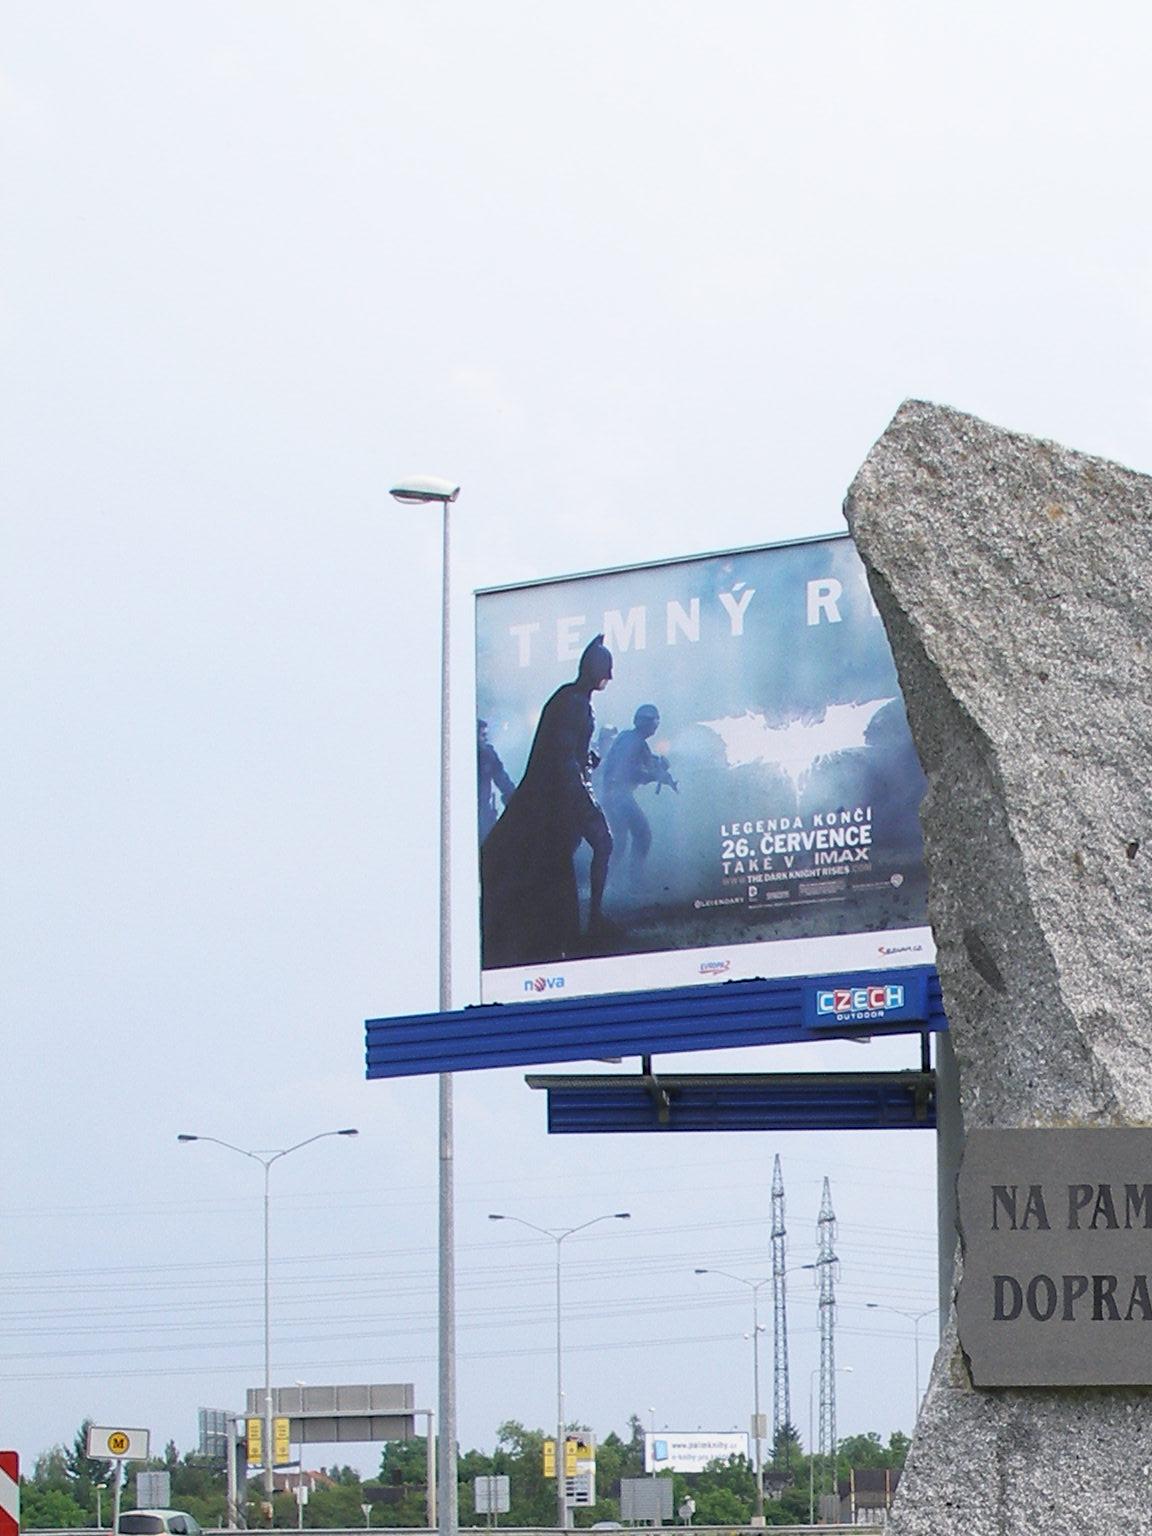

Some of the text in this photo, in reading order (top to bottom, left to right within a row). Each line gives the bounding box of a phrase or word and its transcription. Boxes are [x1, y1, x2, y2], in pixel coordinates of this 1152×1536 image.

[509, 582, 756, 668] TEMNÝ
[721, 816, 803, 837] LEGENDA
[722, 825, 872, 859] 26. ČERVENCE
[784, 855, 795, 868] V
[815, 848, 870, 865] IMAX
[819, 985, 903, 1011] CZECH
[837, 1010, 884, 1021] OUTDOOR
[990, 1184, 1051, 1230] NA
